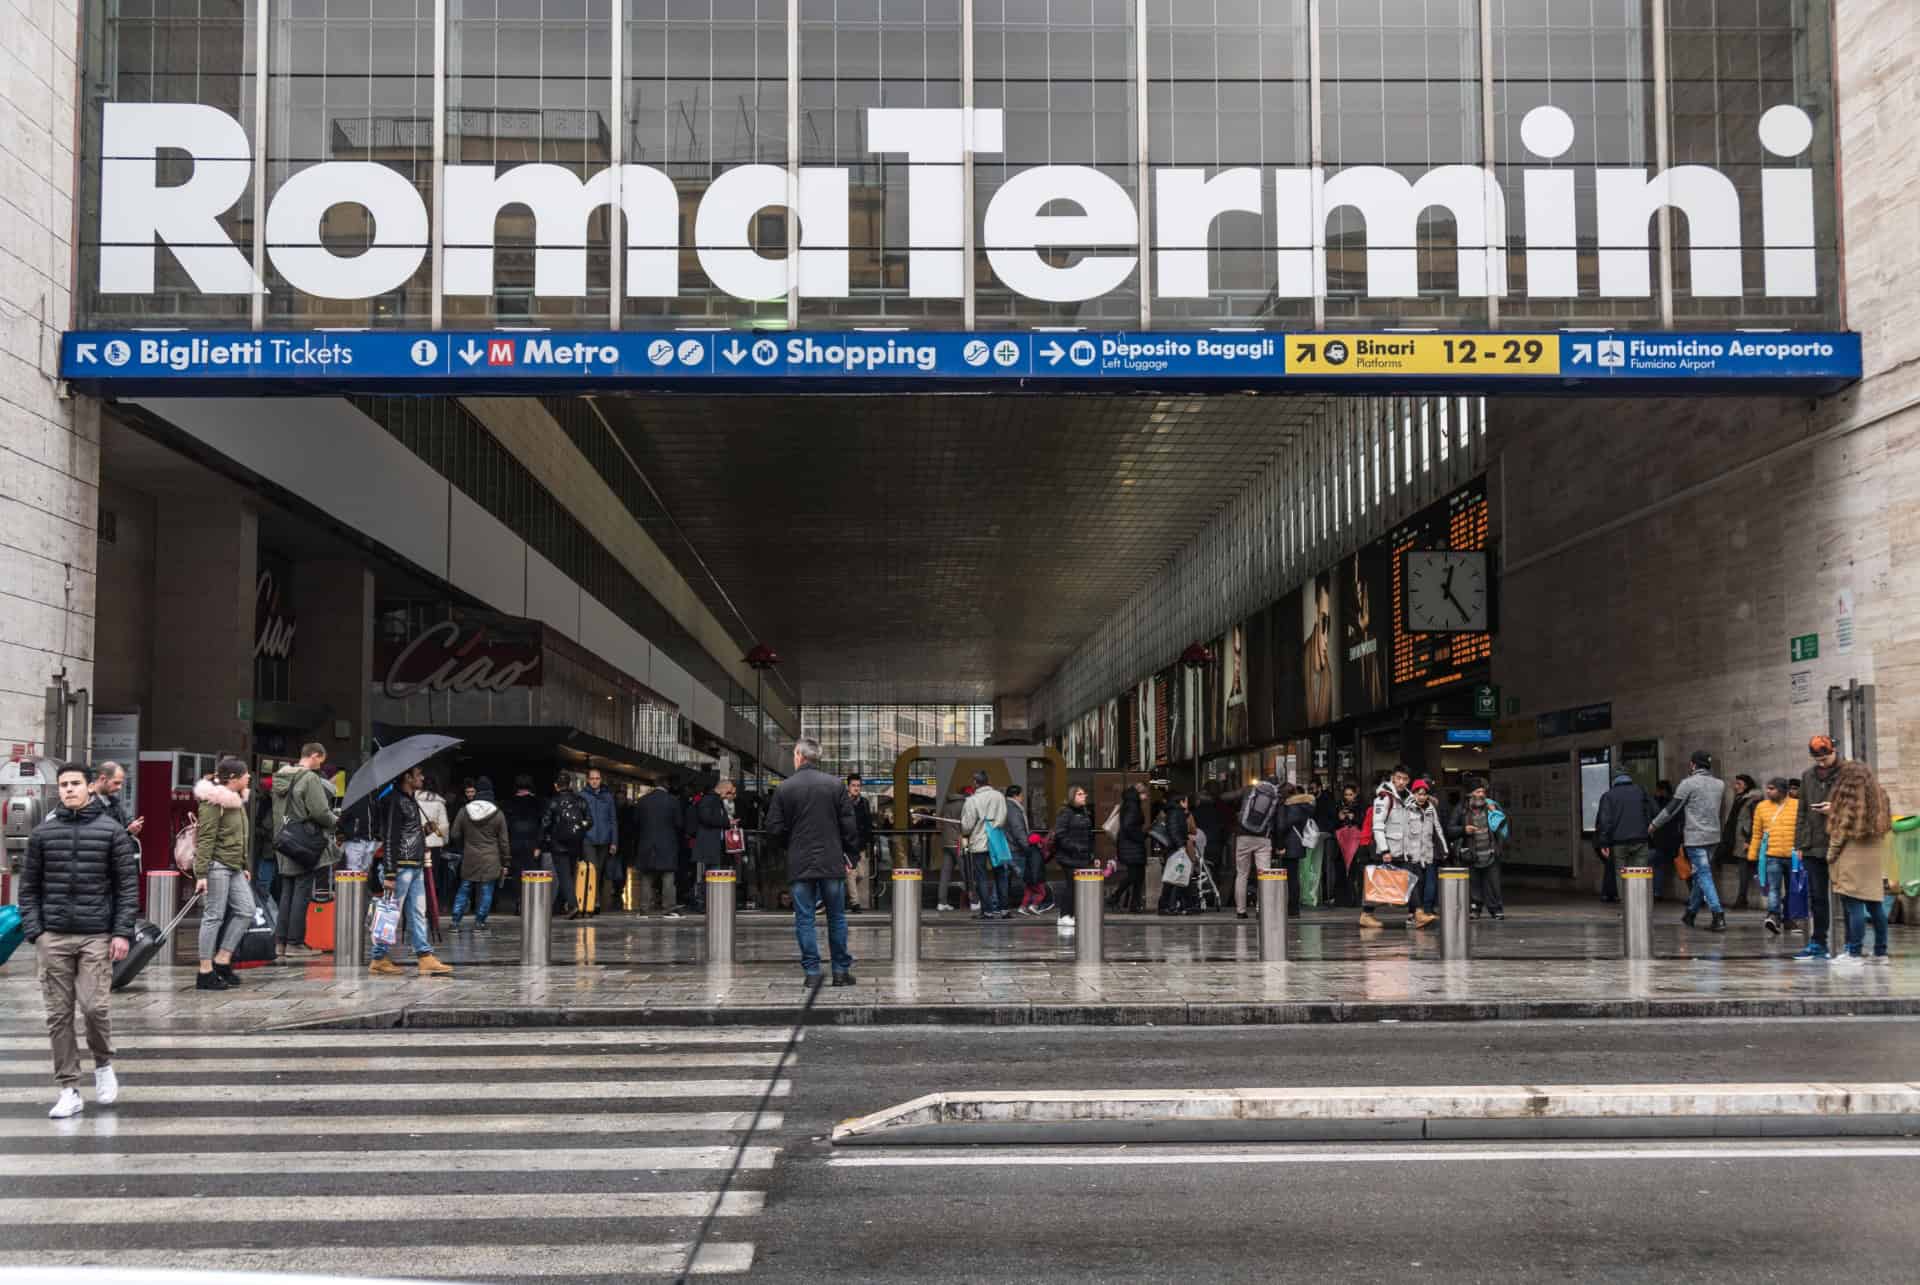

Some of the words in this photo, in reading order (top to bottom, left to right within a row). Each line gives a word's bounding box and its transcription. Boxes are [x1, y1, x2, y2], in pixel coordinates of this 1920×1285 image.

[141, 339, 262, 370] Biglietti
[271, 340, 353, 365] Tickets
[523, 341, 619, 365] Metro
[787, 340, 936, 370] Shopping
[1102, 340, 1191, 359] Deposito
[1197, 339, 1274, 360] Bagagli
[1356, 340, 1415, 355] Binari
[1630, 340, 1723, 357] Fiumicino
[1728, 341, 1833, 360] Aeroporto
[1102, 359, 1124, 369] Left
[1126, 359, 1168, 372] Luggage
[1356, 358, 1402, 369] Platforms
[1631, 358, 1678, 369] Fiumicino
[1680, 358, 1715, 371] Airport
[384, 621, 540, 700] Ciao
